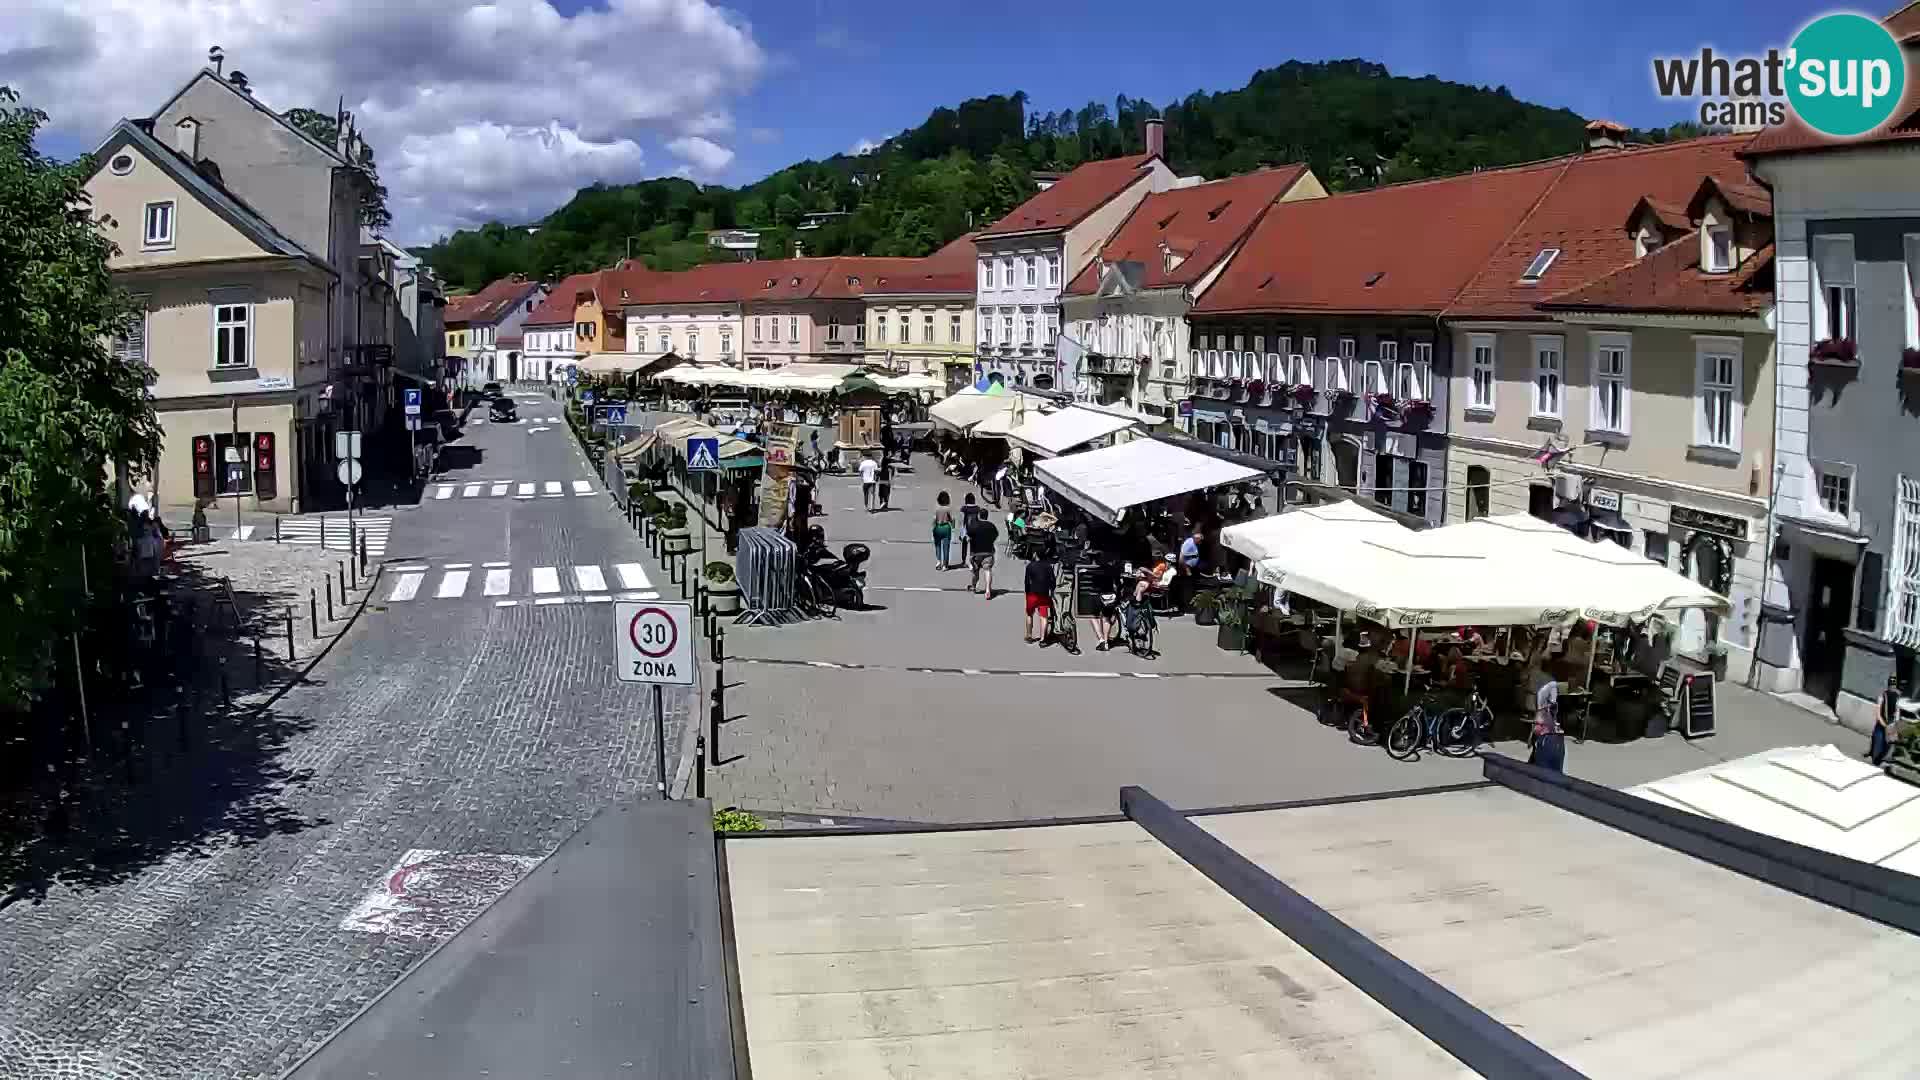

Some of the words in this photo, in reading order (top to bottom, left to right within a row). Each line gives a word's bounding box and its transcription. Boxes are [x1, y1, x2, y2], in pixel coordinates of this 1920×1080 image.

[409, 392, 417, 403] P
[642, 623, 666, 644] 30
[633, 661, 677, 677] ZONA
